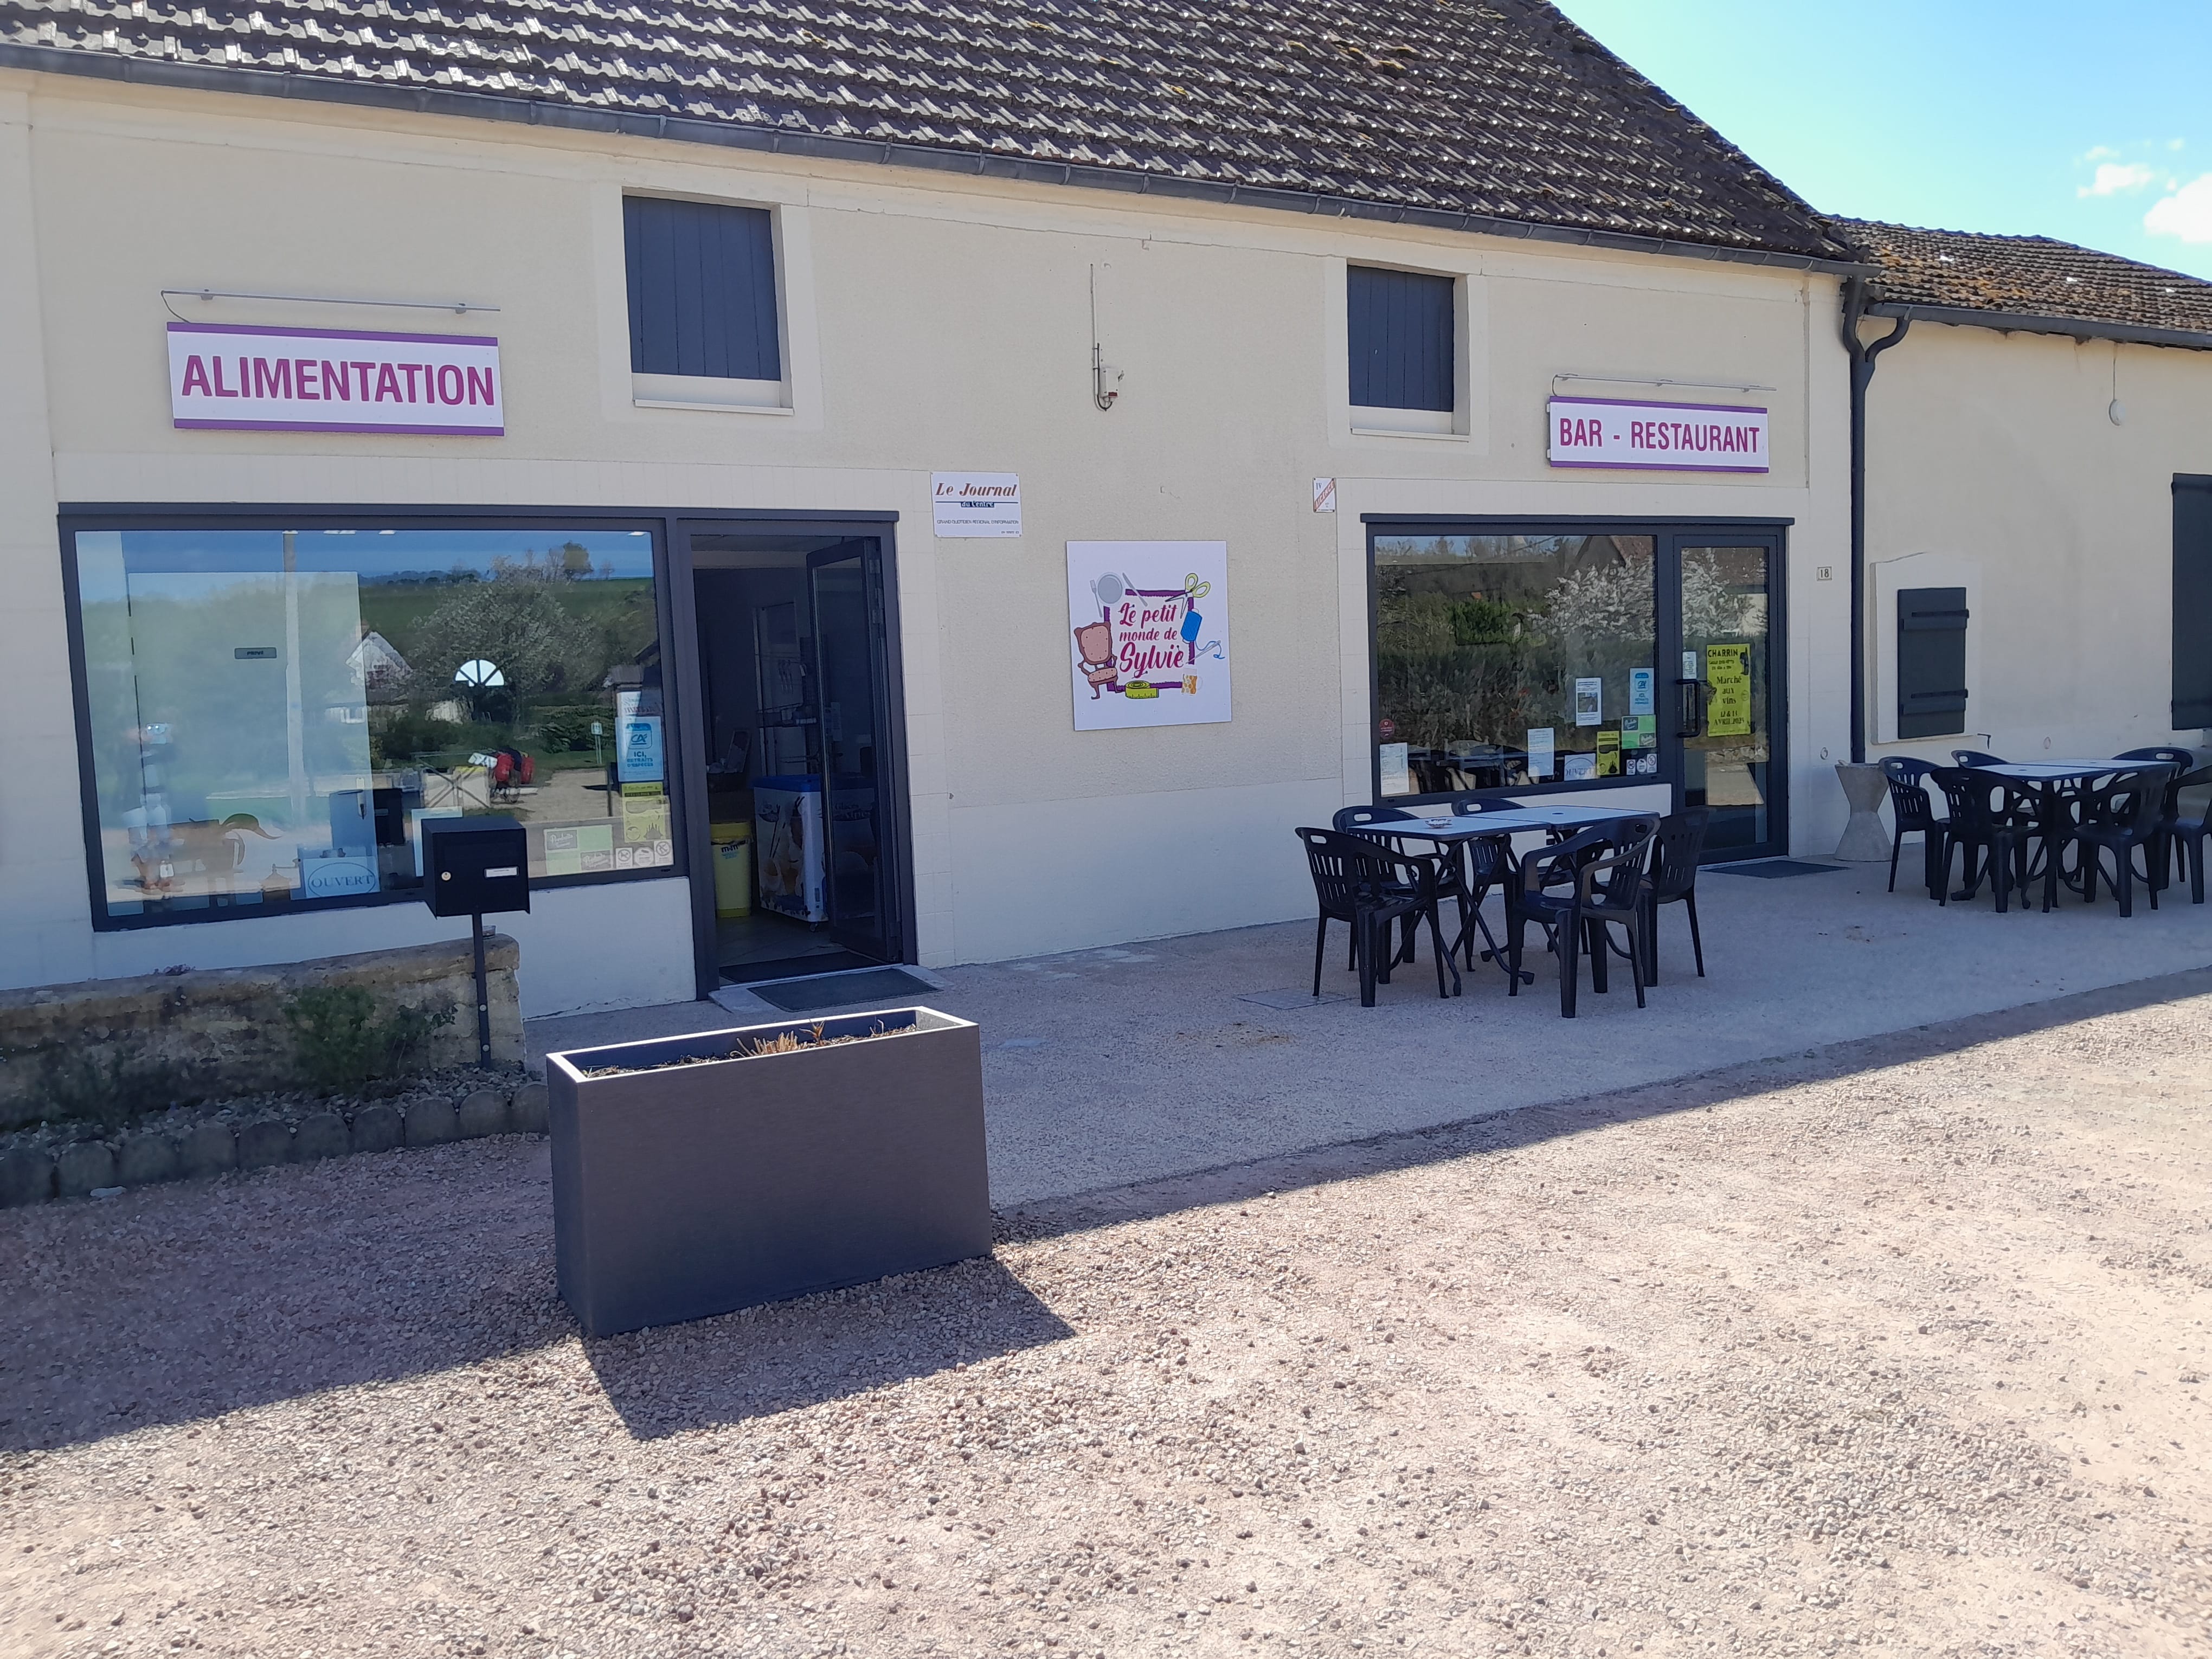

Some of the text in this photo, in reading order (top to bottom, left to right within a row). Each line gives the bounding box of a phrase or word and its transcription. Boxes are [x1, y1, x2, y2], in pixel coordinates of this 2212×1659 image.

[182, 354, 494, 406] ALIMENTATION
[1559, 418, 1603, 447] BAR
[1631, 421, 1760, 453] RESTAURANT
[935, 483, 1018, 497] Le Journal
[1316, 482, 1322, 490] IV
[1315, 480, 1335, 509] LICENCE
[1821, 568, 1829, 578] 18
[1118, 602, 1178, 629] Le petit
[1119, 627, 1178, 642] monde de
[1708, 648, 1738, 657] CHARRIN
[1119, 641, 1184, 679] Sylvie
[1716, 676, 1742, 684] Marché
[311, 875, 373, 888] OUVERT
